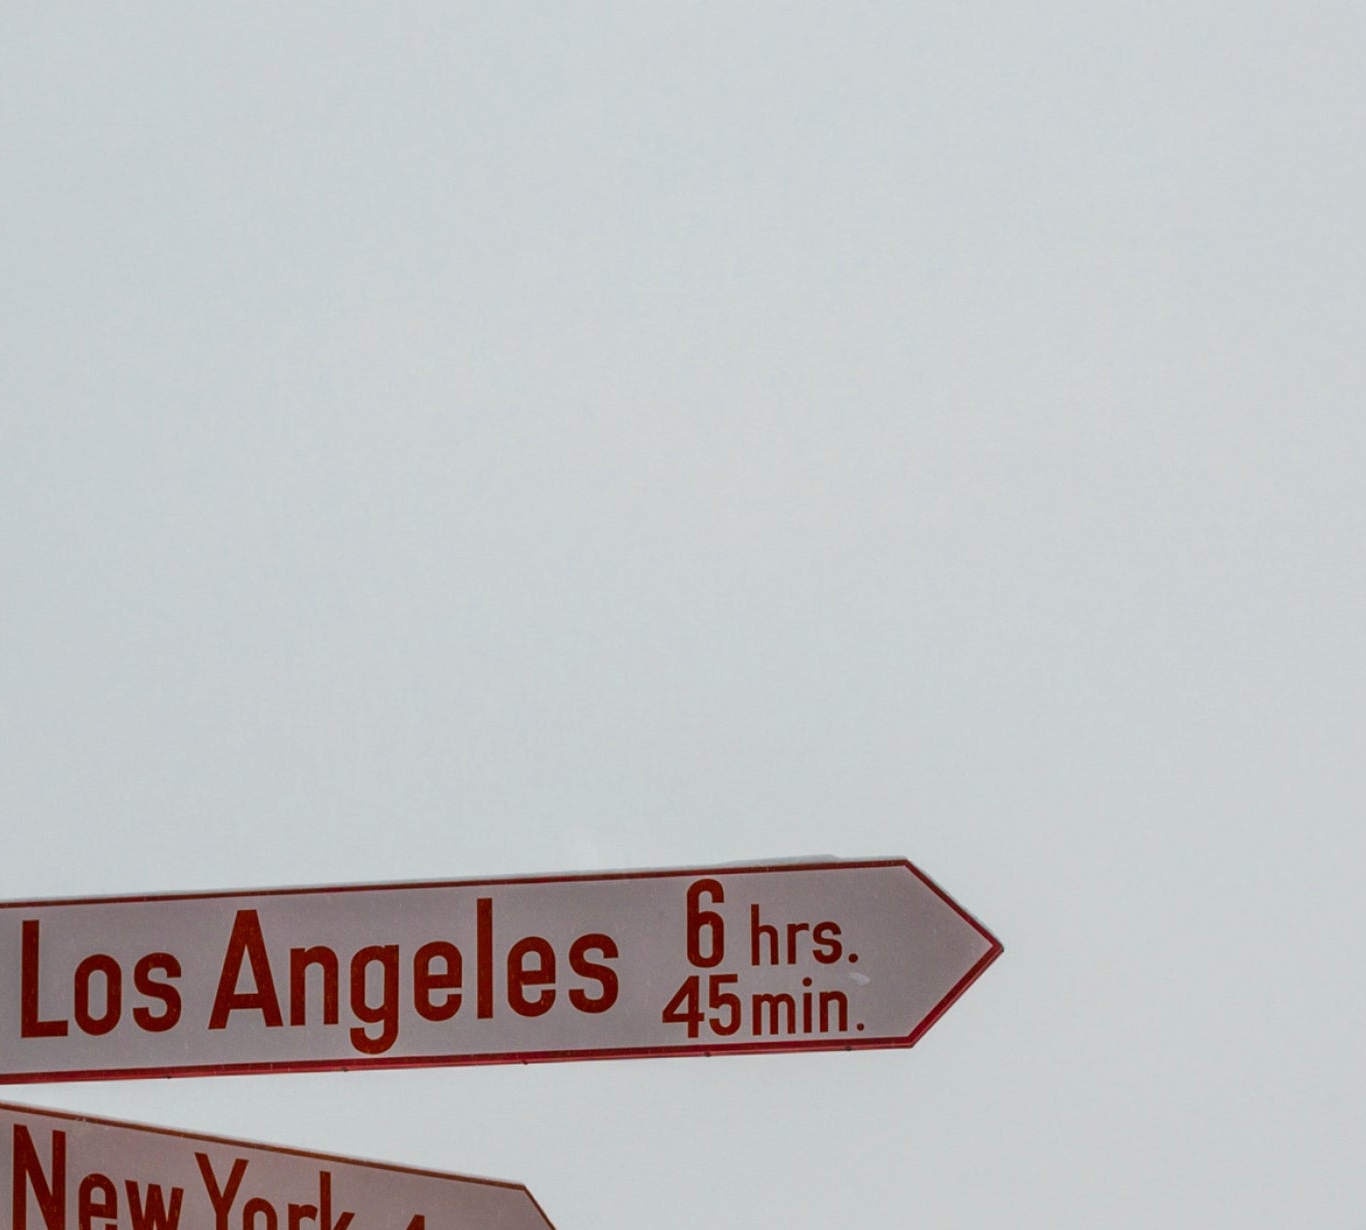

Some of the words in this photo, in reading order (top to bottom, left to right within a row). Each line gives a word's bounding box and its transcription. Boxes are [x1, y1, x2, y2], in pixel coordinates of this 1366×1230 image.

[20, 919, 183, 1039] Los
[207, 896, 620, 1054] Angeles
[686, 878, 724, 969] 6
[749, 903, 858, 967] hrs.
[661, 973, 742, 1040] 45
[751, 977, 865, 1036] min.
